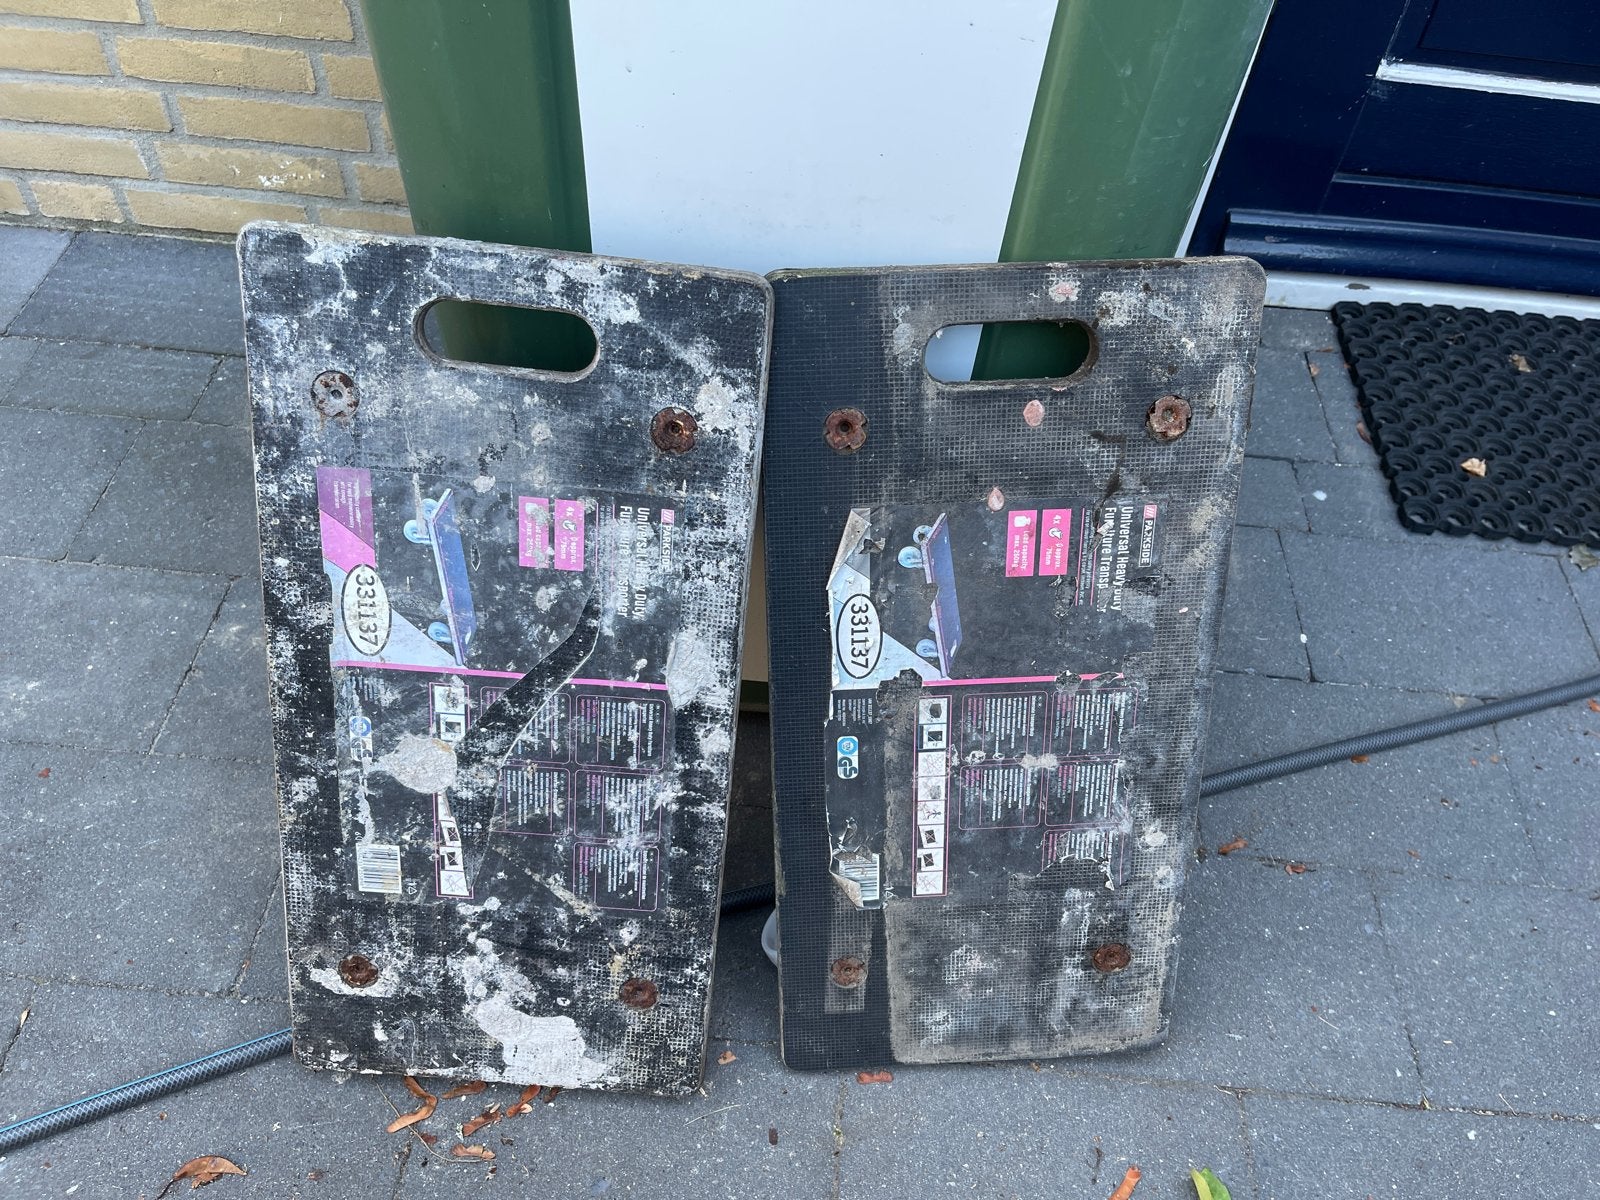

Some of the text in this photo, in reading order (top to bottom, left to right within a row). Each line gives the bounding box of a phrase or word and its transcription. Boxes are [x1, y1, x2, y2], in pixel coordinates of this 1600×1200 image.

[636, 507, 651, 557] Universal
[1053, 514, 1063, 525] 4x
[1117, 506, 1134, 555] Universal
[1141, 519, 1154, 564] PARKSIDE
[661, 525, 672, 570] PARKSIDE
[1112, 556, 1129, 588] Heavy
[355, 573, 379, 647] 331137
[850, 602, 869, 669] 331137
[838, 756, 858, 779] GS
